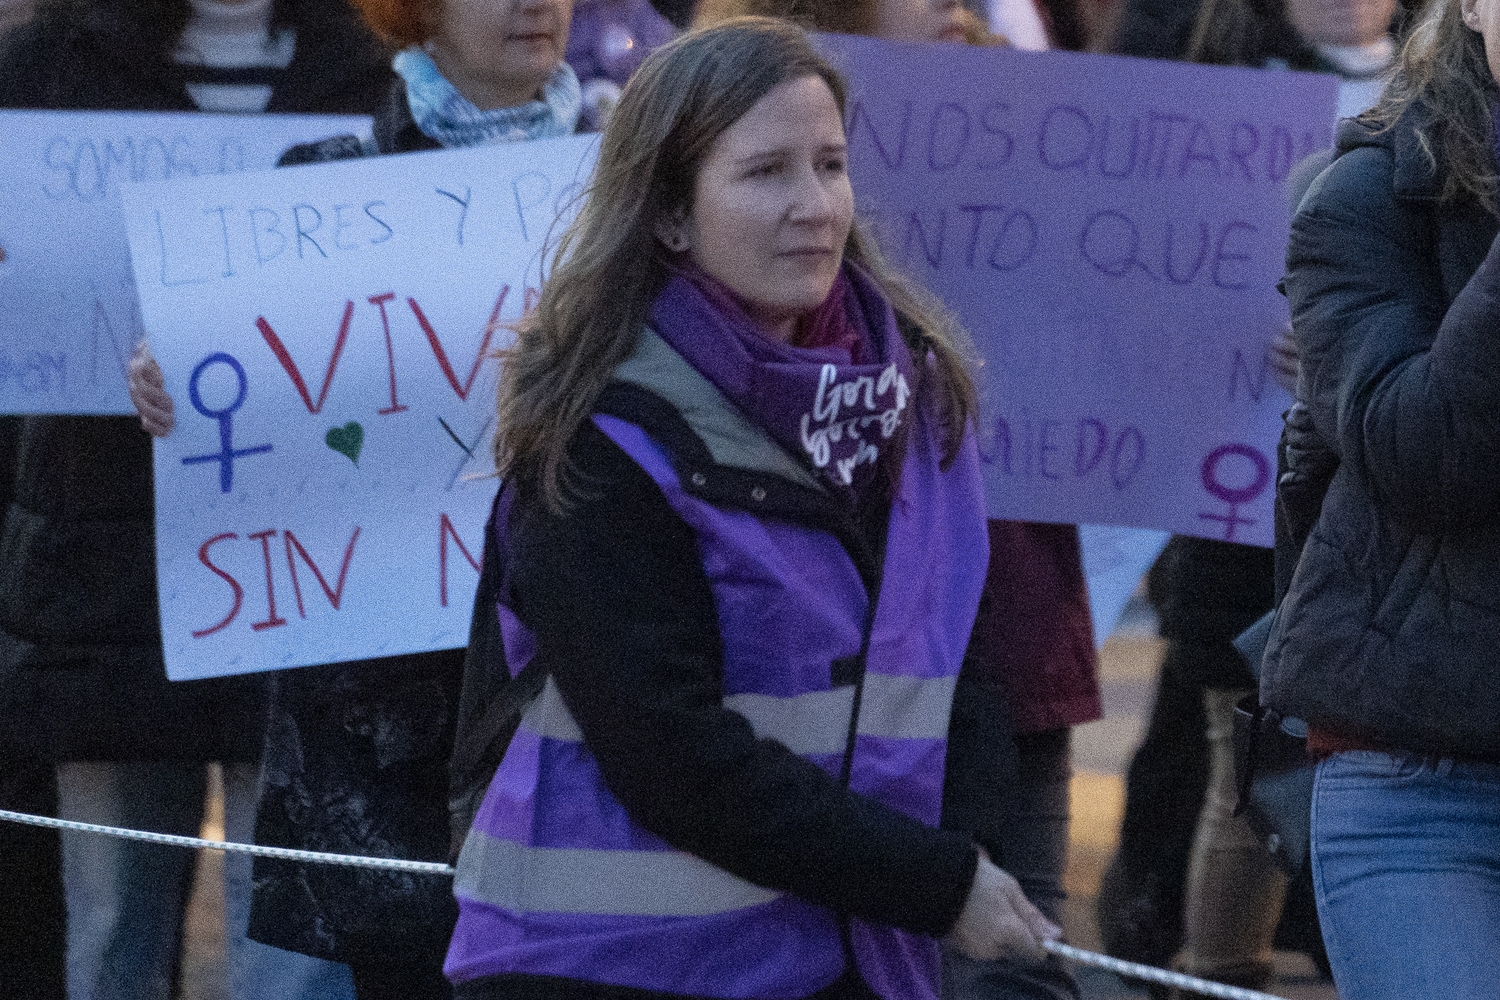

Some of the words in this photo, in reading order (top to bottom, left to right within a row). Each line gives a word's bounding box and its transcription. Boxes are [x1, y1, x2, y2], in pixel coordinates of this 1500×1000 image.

[847, 99, 1017, 173] NOS
[1036, 102, 1313, 184] QUITARO
[153, 199, 394, 287] LIBRES
[435, 186, 472, 246] Y
[511, 169, 588, 244] PO
[902, 204, 1039, 275] NTO
[1077, 207, 1261, 292] QUE
[255, 283, 540, 416] VIV
[192, 525, 362, 638] SIN
